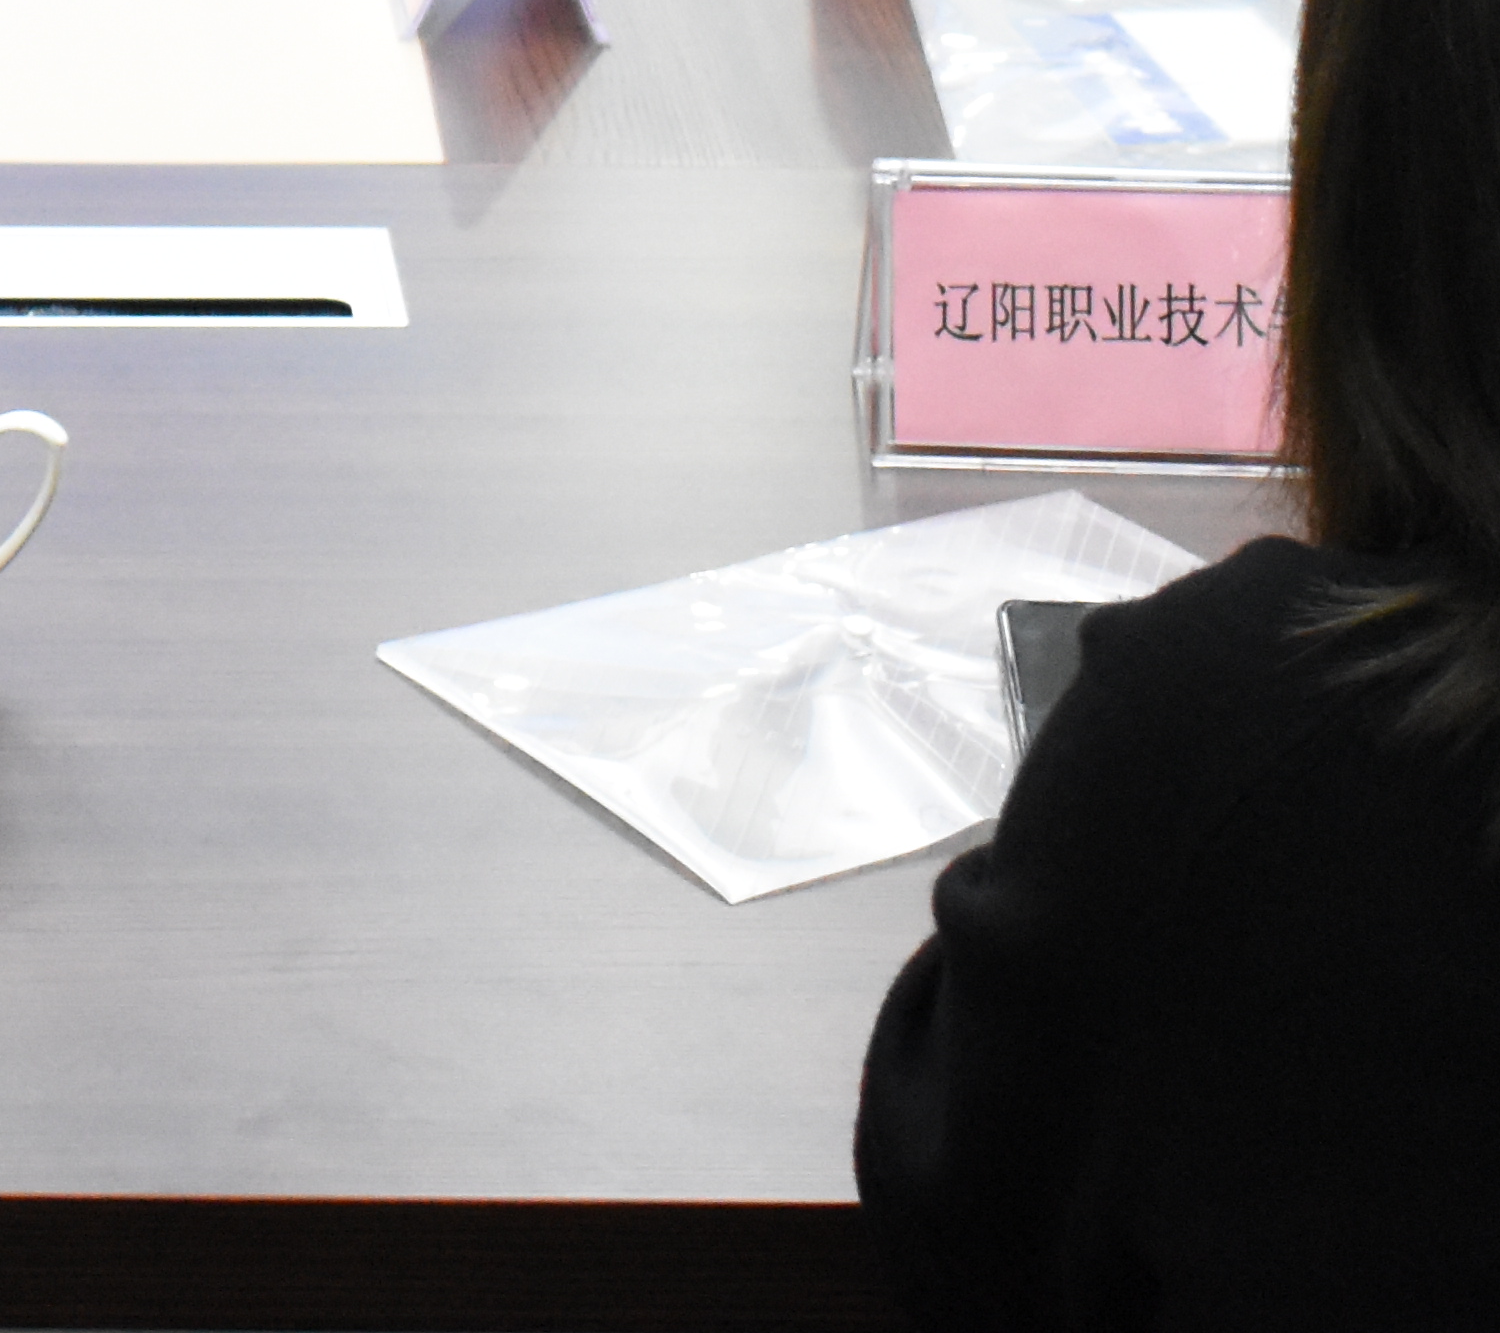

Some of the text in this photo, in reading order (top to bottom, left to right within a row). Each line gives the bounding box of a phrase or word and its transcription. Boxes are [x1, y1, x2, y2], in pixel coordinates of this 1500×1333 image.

[934, 280, 1290, 347] 辽阳职业技术
